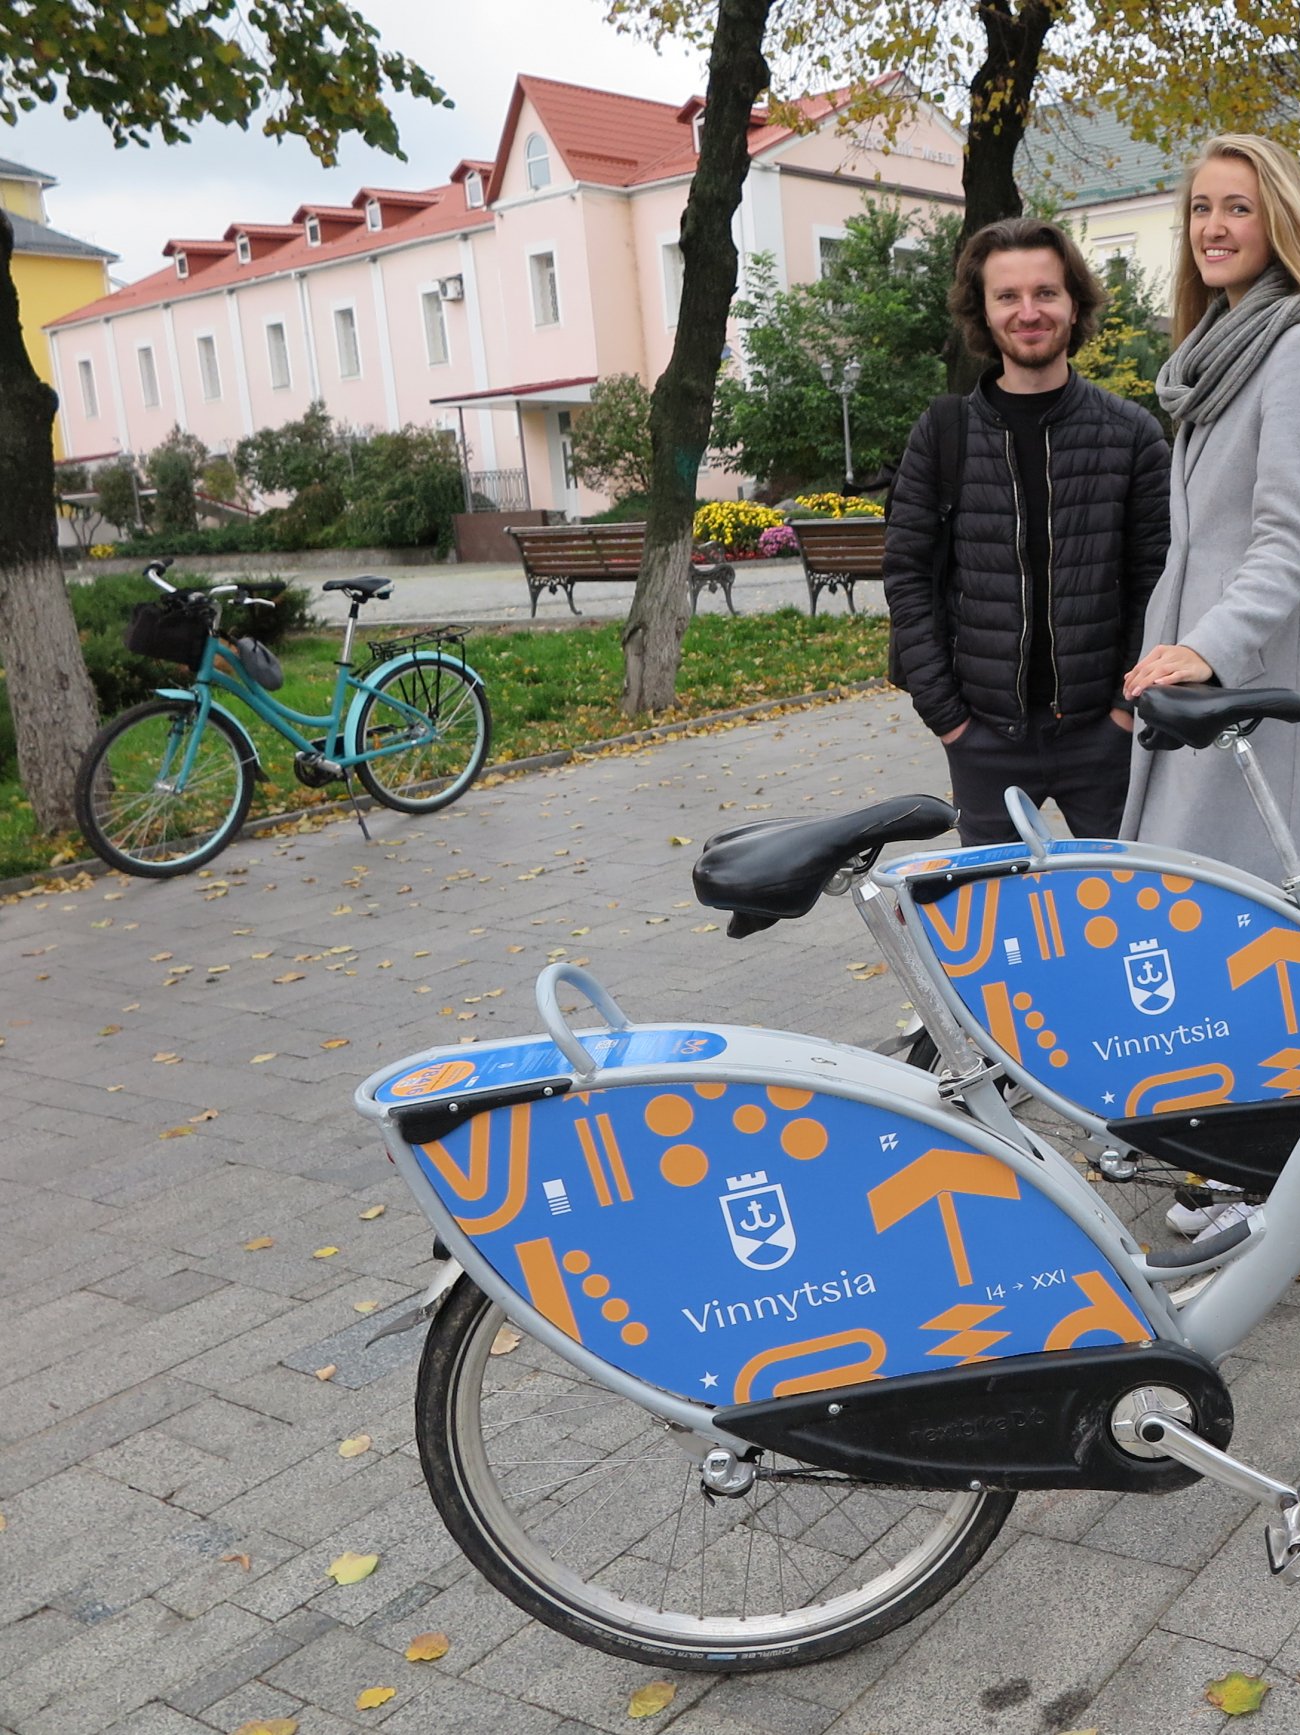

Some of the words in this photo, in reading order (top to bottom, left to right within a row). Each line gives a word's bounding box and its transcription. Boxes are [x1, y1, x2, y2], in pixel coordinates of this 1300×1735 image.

[1092, 1017, 1230, 1061] Vinnytsia
[1030, 1268, 1067, 1290] XXI
[681, 1269, 877, 1333] Vinnytsia
[741, 1645, 799, 1660] SCHWALBE
